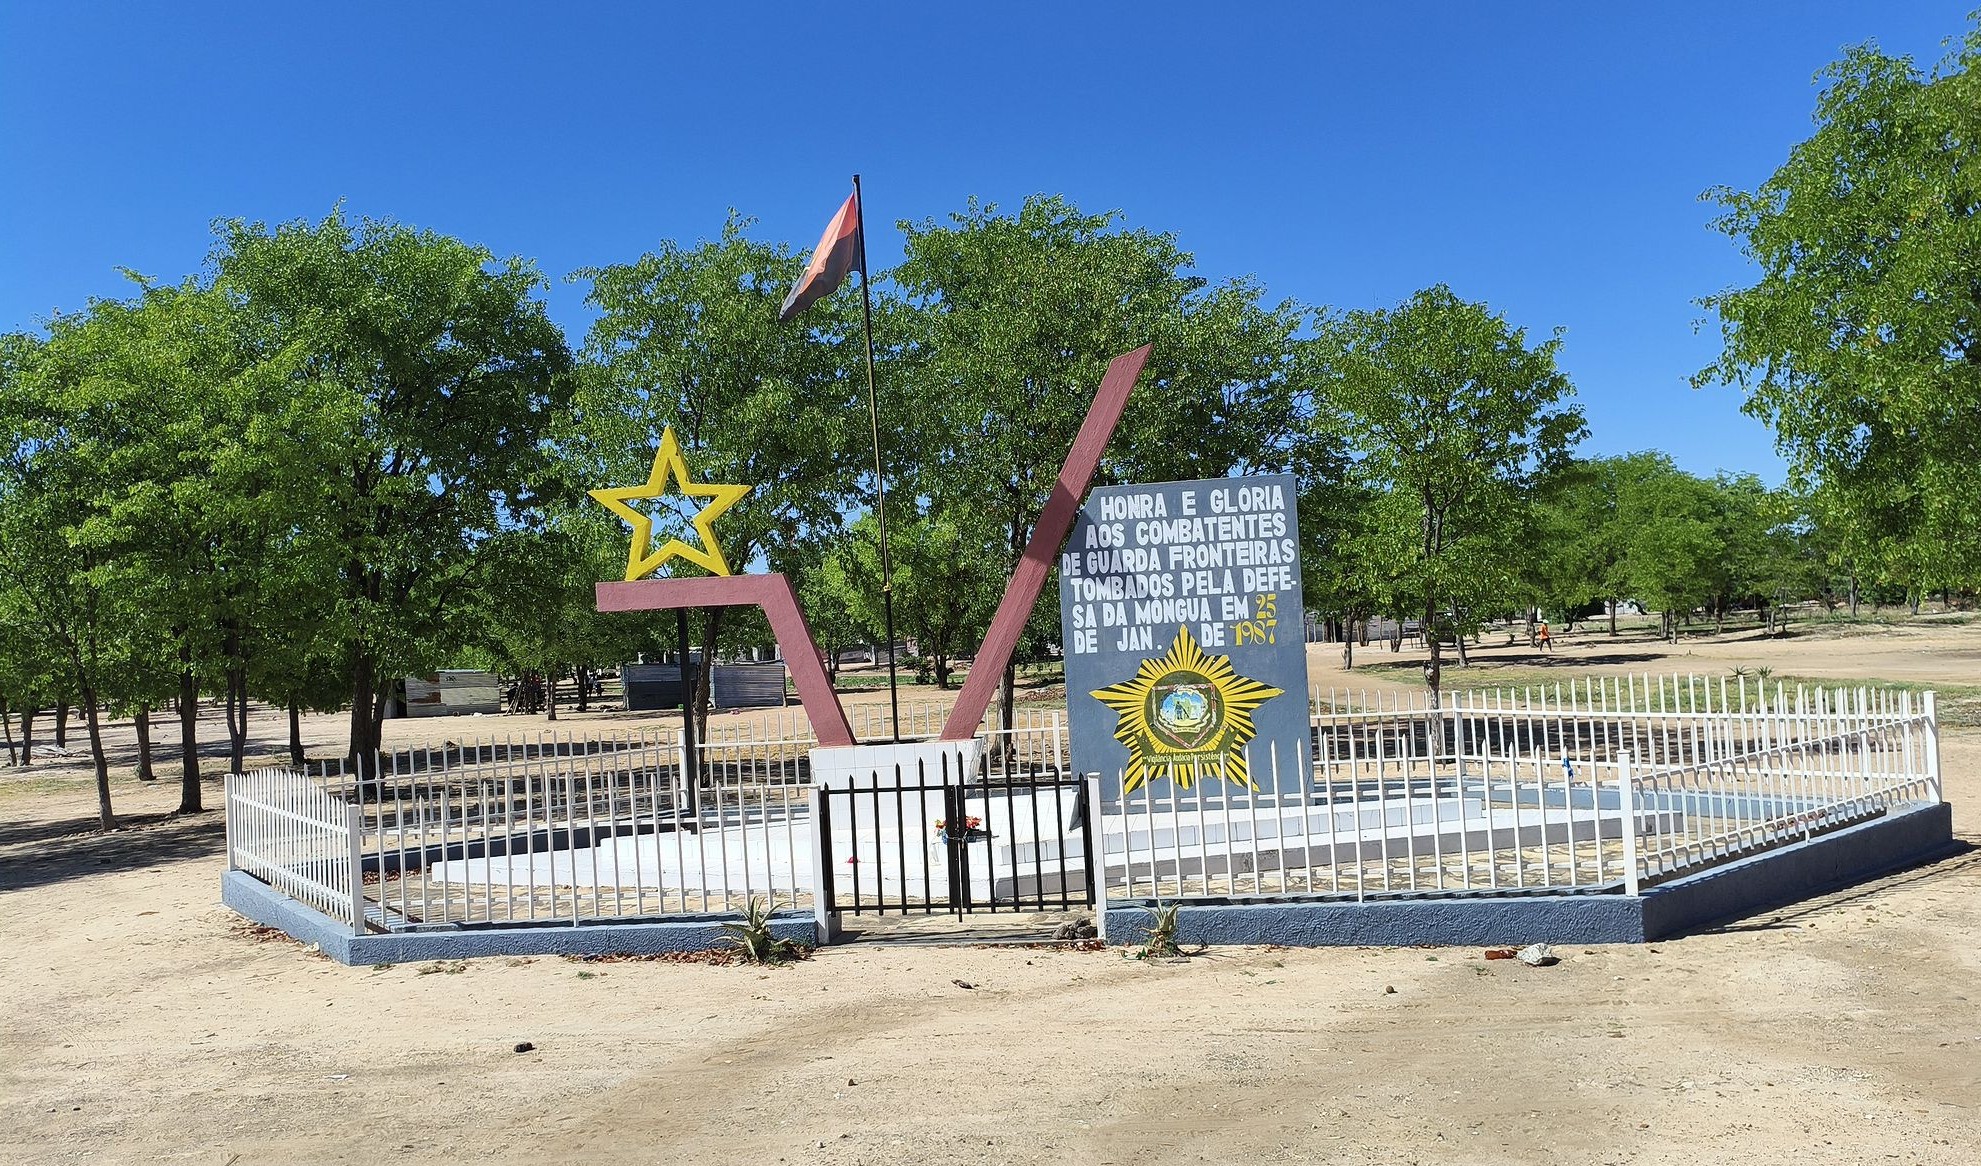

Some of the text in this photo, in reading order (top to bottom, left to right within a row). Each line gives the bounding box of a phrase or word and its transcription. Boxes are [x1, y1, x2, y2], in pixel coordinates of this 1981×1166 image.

[1101, 485, 1284, 521] HONRA E GLÓRIA
[1086, 513, 1286, 548] AOS COMBATENTES
[1063, 539, 1295, 576] DE GUARDA FRONTEIRAS
[1071, 566, 1296, 602] TOMBADOS PELA DEFE-
[1072, 604, 1097, 628] SA
[1103, 602, 1128, 627] DA
[1222, 596, 1249, 621] EM
[1255, 594, 1277, 619] 25
[1074, 620, 1277, 654] DE JAN. DE 1987
